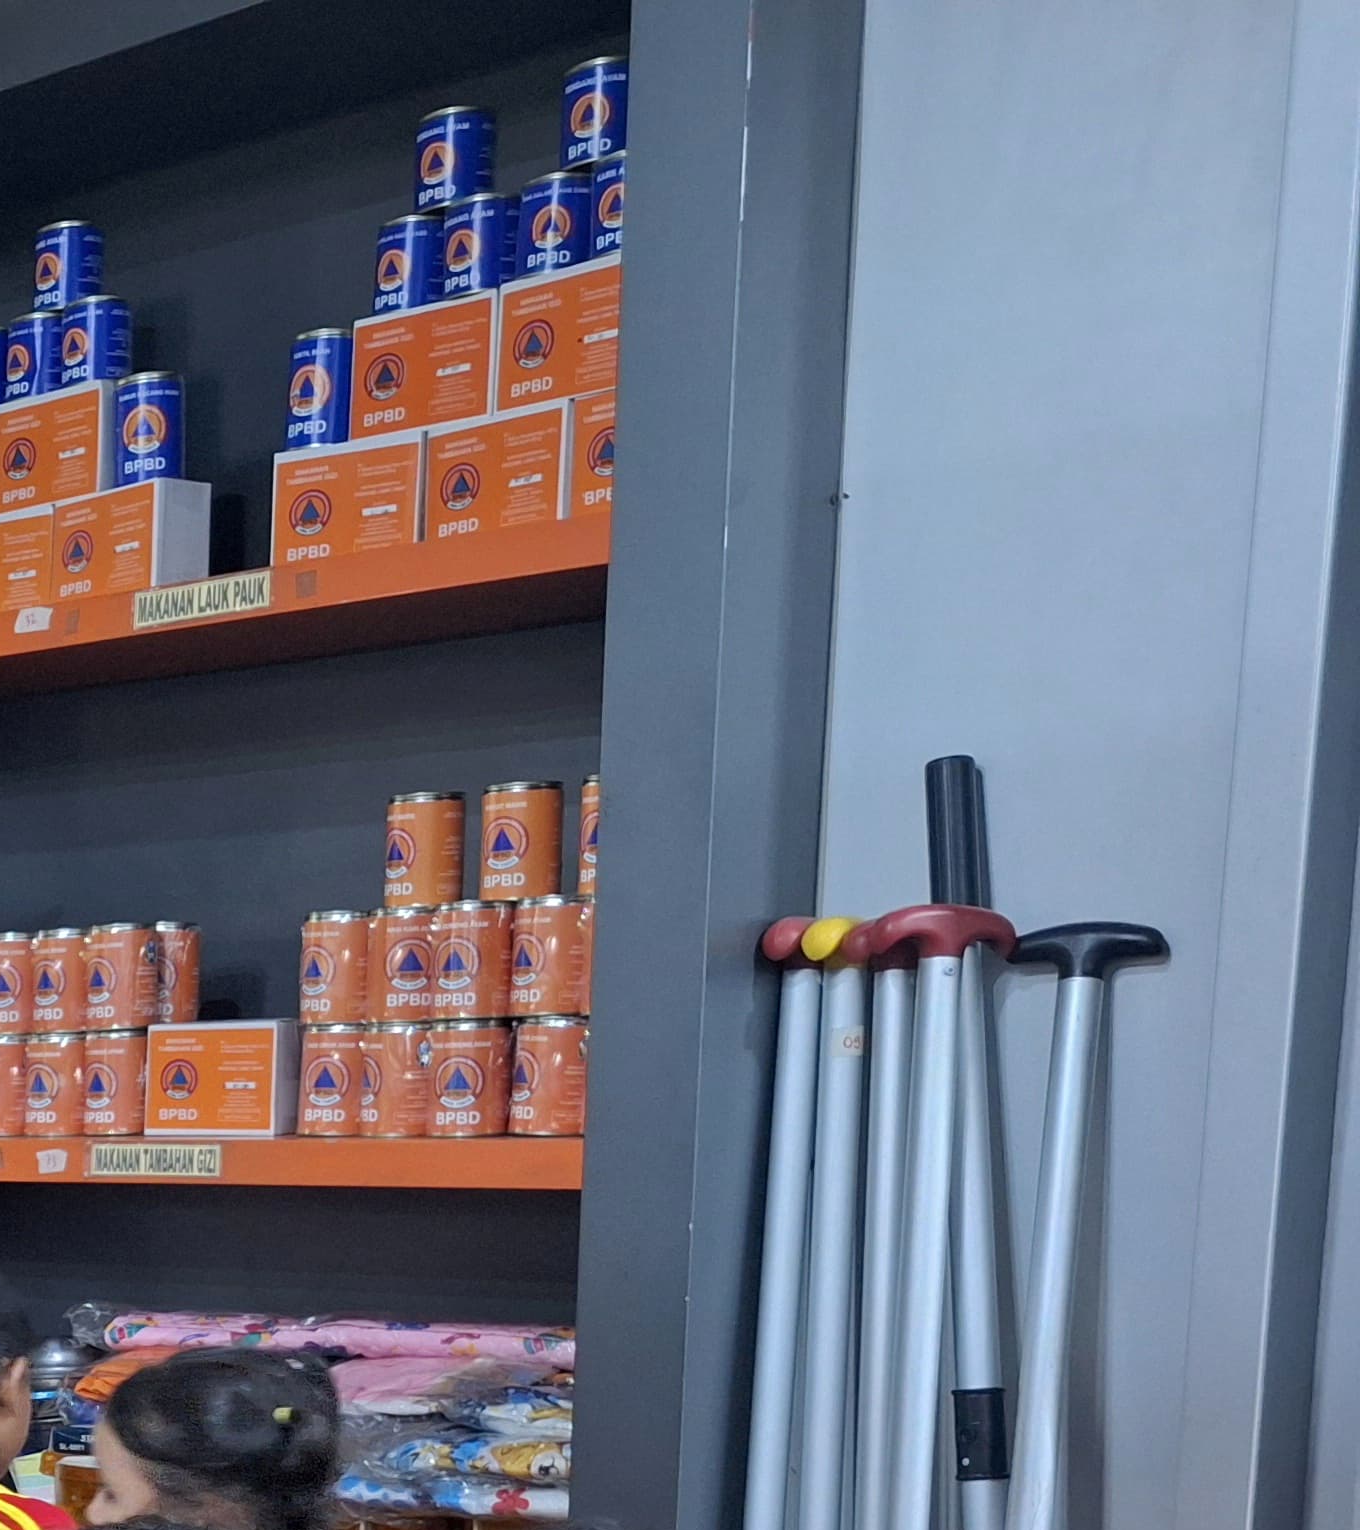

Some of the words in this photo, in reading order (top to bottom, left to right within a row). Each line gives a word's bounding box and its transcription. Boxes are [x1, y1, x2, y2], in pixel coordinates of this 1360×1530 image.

[527, 250, 570, 269] BPBD
[510, 376, 553, 398] BPBD
[363, 407, 406, 428] BPBD
[288, 420, 327, 438] BPBD
[124, 457, 166, 474] BPBD
[2, 486, 36, 504] BPBD
[438, 518, 479, 538] BPBD
[286, 543, 330, 562] BPBD
[60, 579, 92, 597] BPBD
[137, 595, 194, 624] MAKANAN
[197, 584, 229, 613] LAUK
[233, 579, 266, 608] PAUK
[483, 873, 525, 888] BPBD
[386, 994, 430, 1008] BPBD
[434, 992, 476, 1007] BPBD
[158, 1108, 198, 1121] BPBD
[304, 1109, 346, 1122] BPBD
[436, 1111, 480, 1126] BPBD
[95, 1149, 140, 1172] MAKANAN
[143, 1149, 194, 1173] TAMBAHAN
[197, 1149, 216, 1173] GIZI
